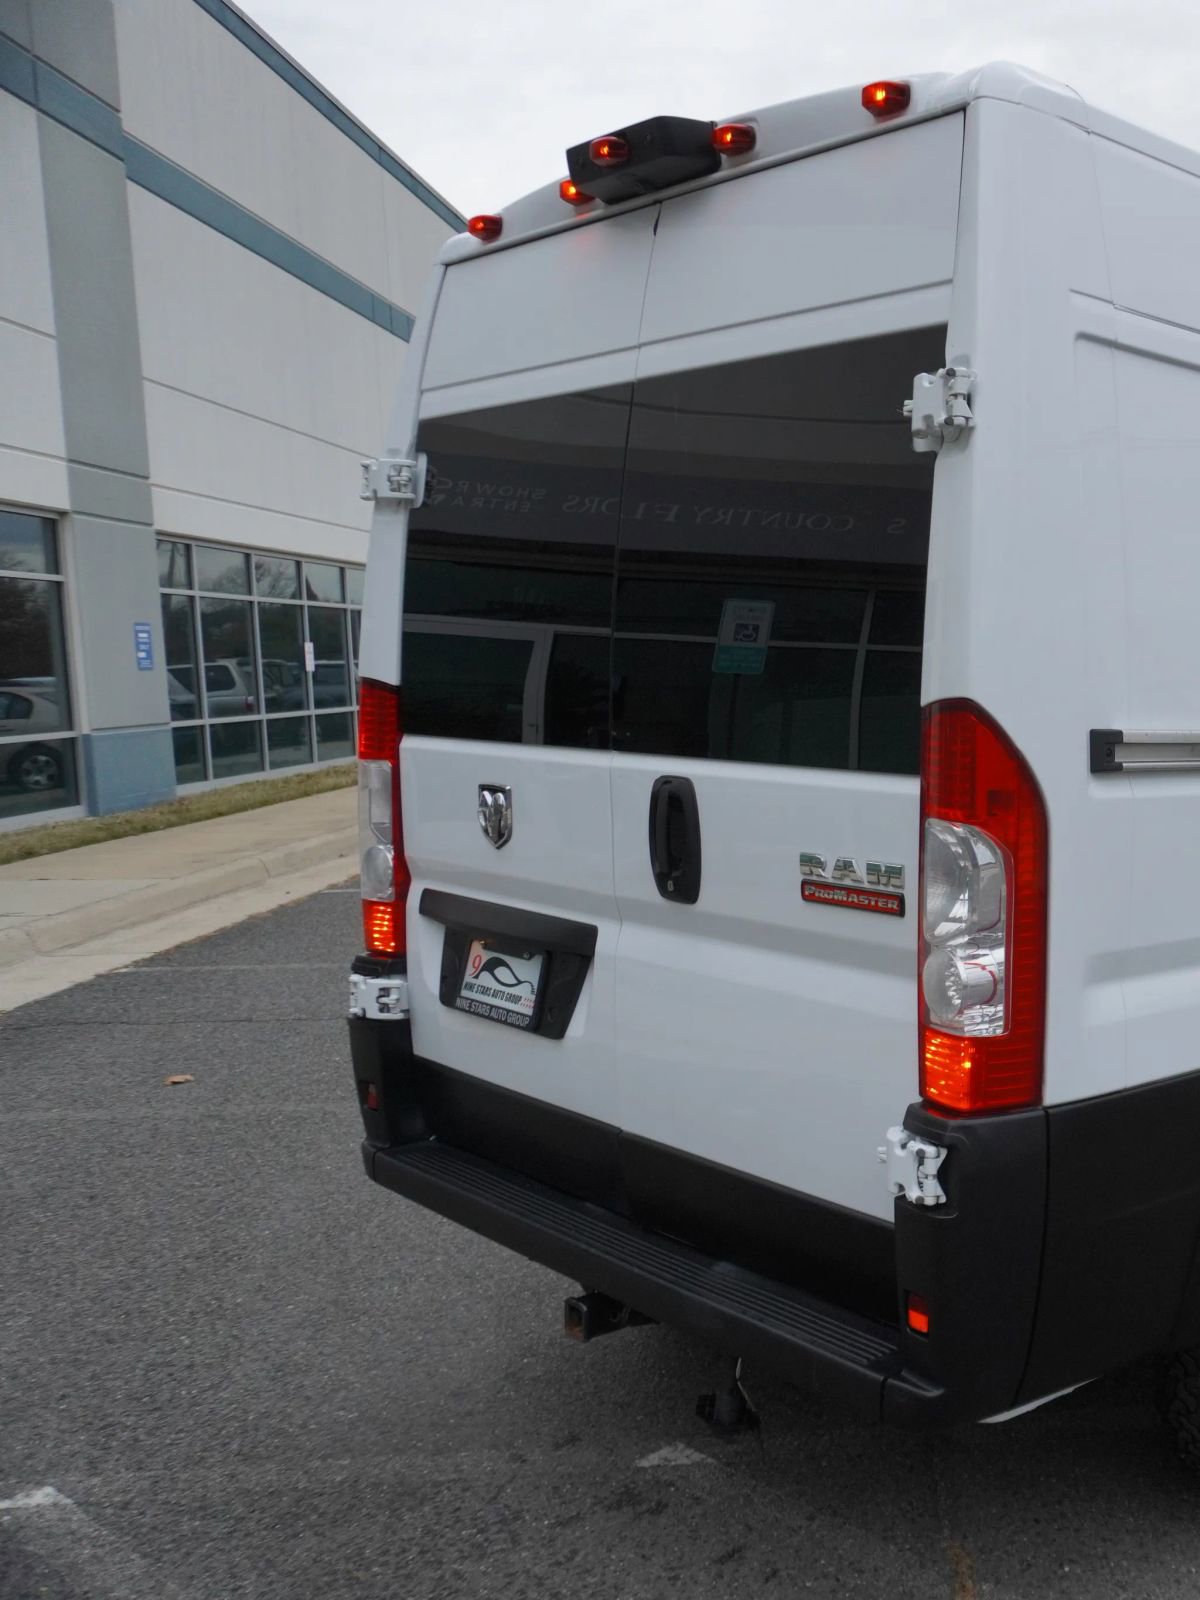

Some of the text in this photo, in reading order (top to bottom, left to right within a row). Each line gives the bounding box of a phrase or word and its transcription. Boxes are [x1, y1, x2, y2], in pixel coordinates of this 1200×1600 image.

[800, 852, 905, 890] RAM
[464, 981, 522, 1004] NINE STARS AUTO GROUP
[456, 998, 530, 1027] NINE STARS AUTO GROUP
